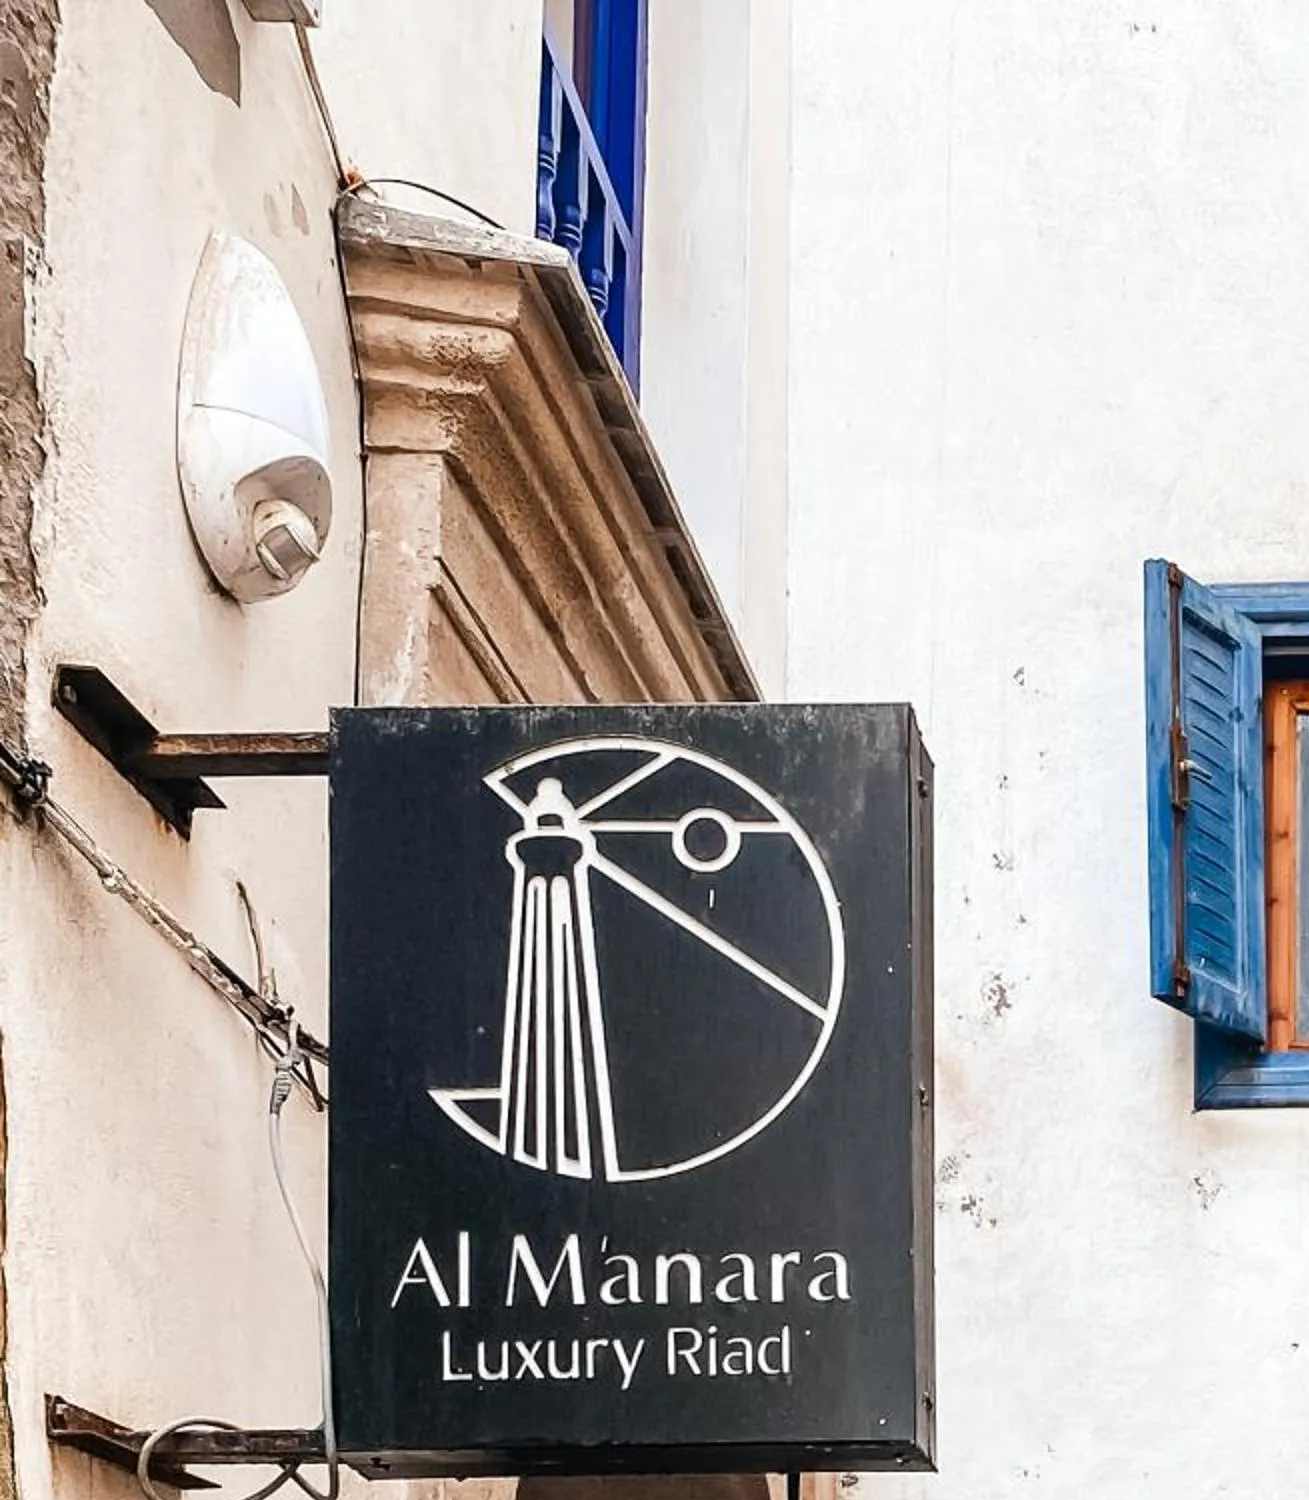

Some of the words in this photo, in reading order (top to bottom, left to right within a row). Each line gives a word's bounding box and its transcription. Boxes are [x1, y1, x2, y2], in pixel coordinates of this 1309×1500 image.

[390, 1231, 470, 1308] Al
[441, 1330, 645, 1390] Luxury
[666, 1324, 791, 1377] Riad
